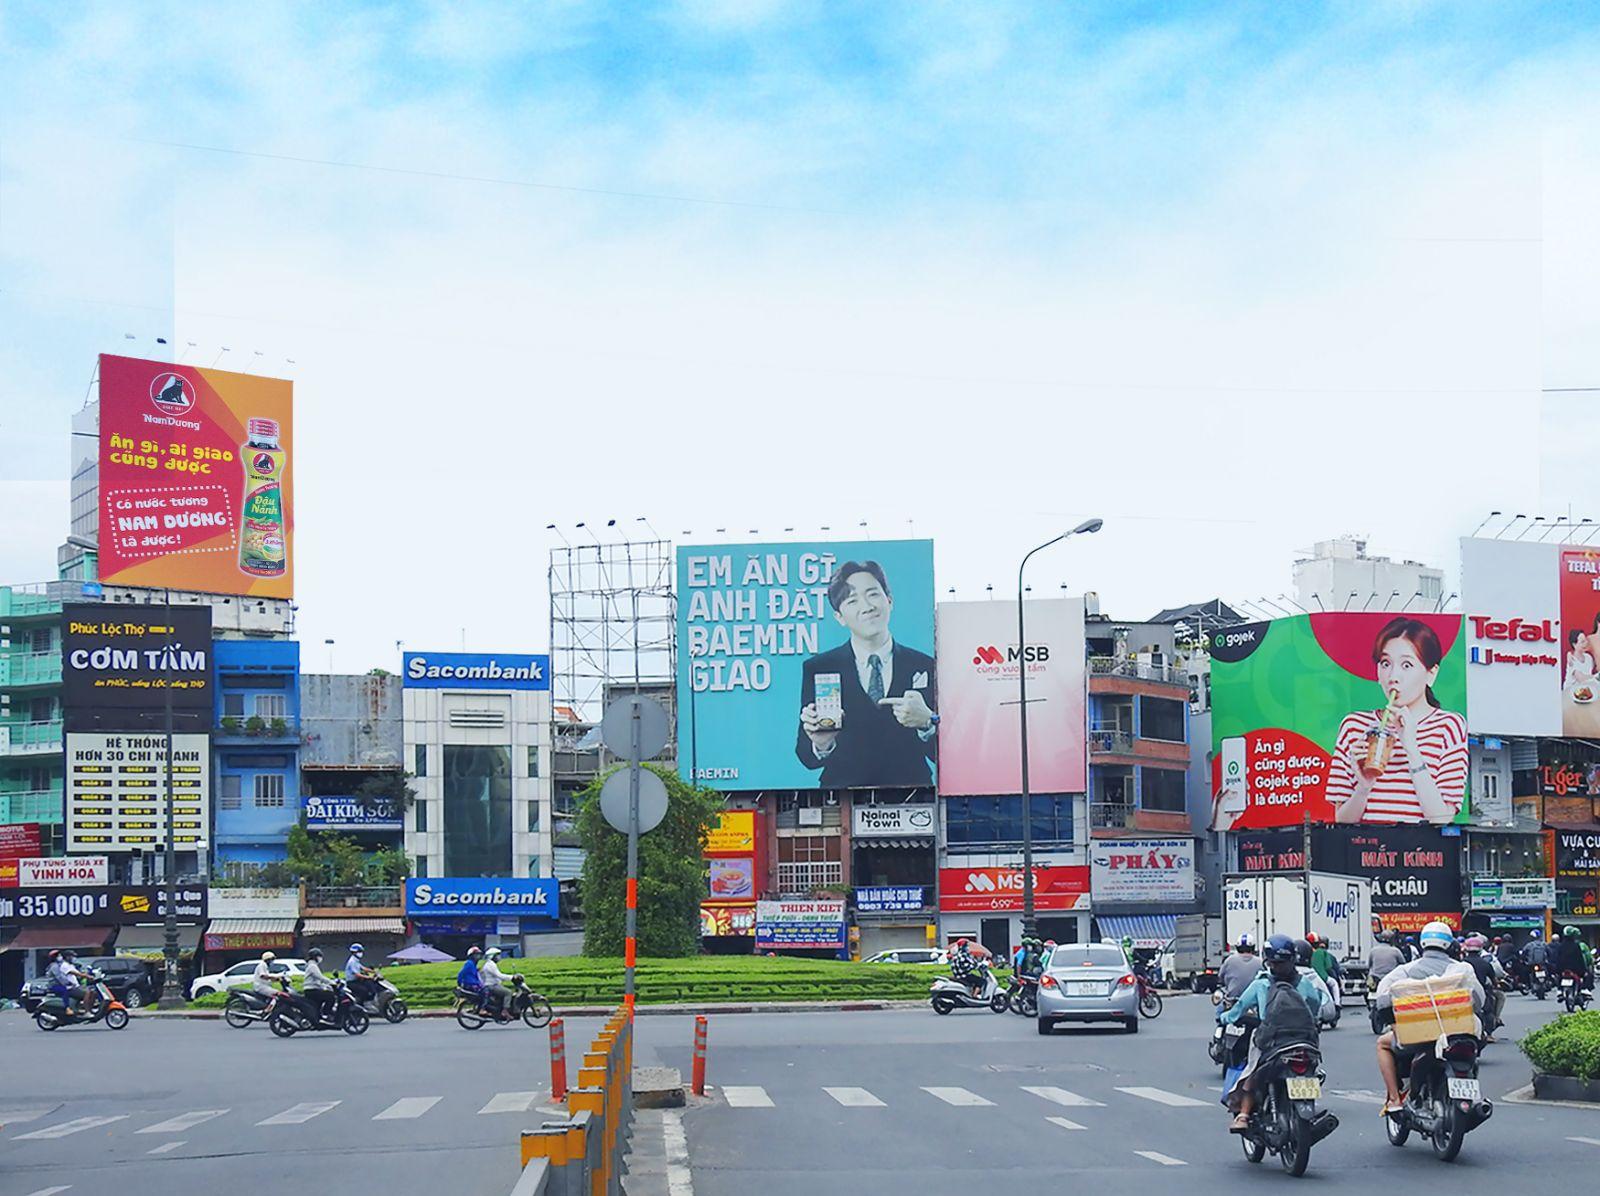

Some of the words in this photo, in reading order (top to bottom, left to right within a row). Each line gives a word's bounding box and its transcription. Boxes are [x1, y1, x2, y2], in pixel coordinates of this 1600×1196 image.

[110, 432, 134, 450] Ăn
[140, 440, 166, 455] gì,
[170, 444, 187, 456] ai
[193, 447, 234, 462] giao
[110, 451, 158, 469] cũng
[165, 457, 212, 476] được
[116, 496, 132, 510] Có
[135, 495, 167, 508] nước
[118, 516, 159, 532] NAM
[164, 511, 227, 529] DƯƠNG
[141, 534, 182, 548] được!
[687, 555, 732, 588] EM
[742, 554, 788, 586] ĂN
[687, 590, 757, 622] ANH
[766, 587, 829, 620] ĐẶT
[70, 622, 98, 634] Phúc
[102, 623, 122, 638] Lộc
[124, 624, 146, 638] Thọ
[688, 622, 819, 657] BAEMIN
[1226, 631, 1255, 646] gojek
[1469, 616, 1559, 643] Tefal
[70, 646, 138, 670] CƠM
[144, 642, 206, 670] TẤM
[1008, 646, 1050, 662] MSB
[408, 656, 542, 680] Sacombank
[688, 658, 771, 692] GIAO
[76, 750, 102, 760] HƠN
[106, 751, 124, 760] 30
[128, 752, 150, 760] CHI
[1254, 739, 1272, 754] Ăn
[1274, 739, 1285, 755] gì
[1254, 757, 1286, 773] cũng
[1287, 755, 1325, 770] được,
[1255, 776, 1290, 791] Gojek
[1292, 774, 1320, 788] giao
[1255, 793, 1267, 806] là
[1268, 792, 1302, 806] được!
[335, 804, 364, 818] KIM
[1562, 834, 1584, 851] VỰA
[1109, 848, 1177, 870] PHẤY
[1362, 844, 1398, 866] MẮT
[1404, 847, 1443, 866] KÍNH
[32, 868, 64, 880] VINH
[414, 884, 547, 905] Sacombank
[1371, 876, 1382, 896] Á
[1385, 876, 1428, 896] CHÂU
[19, 894, 94, 917] 35.000
[100, 894, 108, 908] đ
